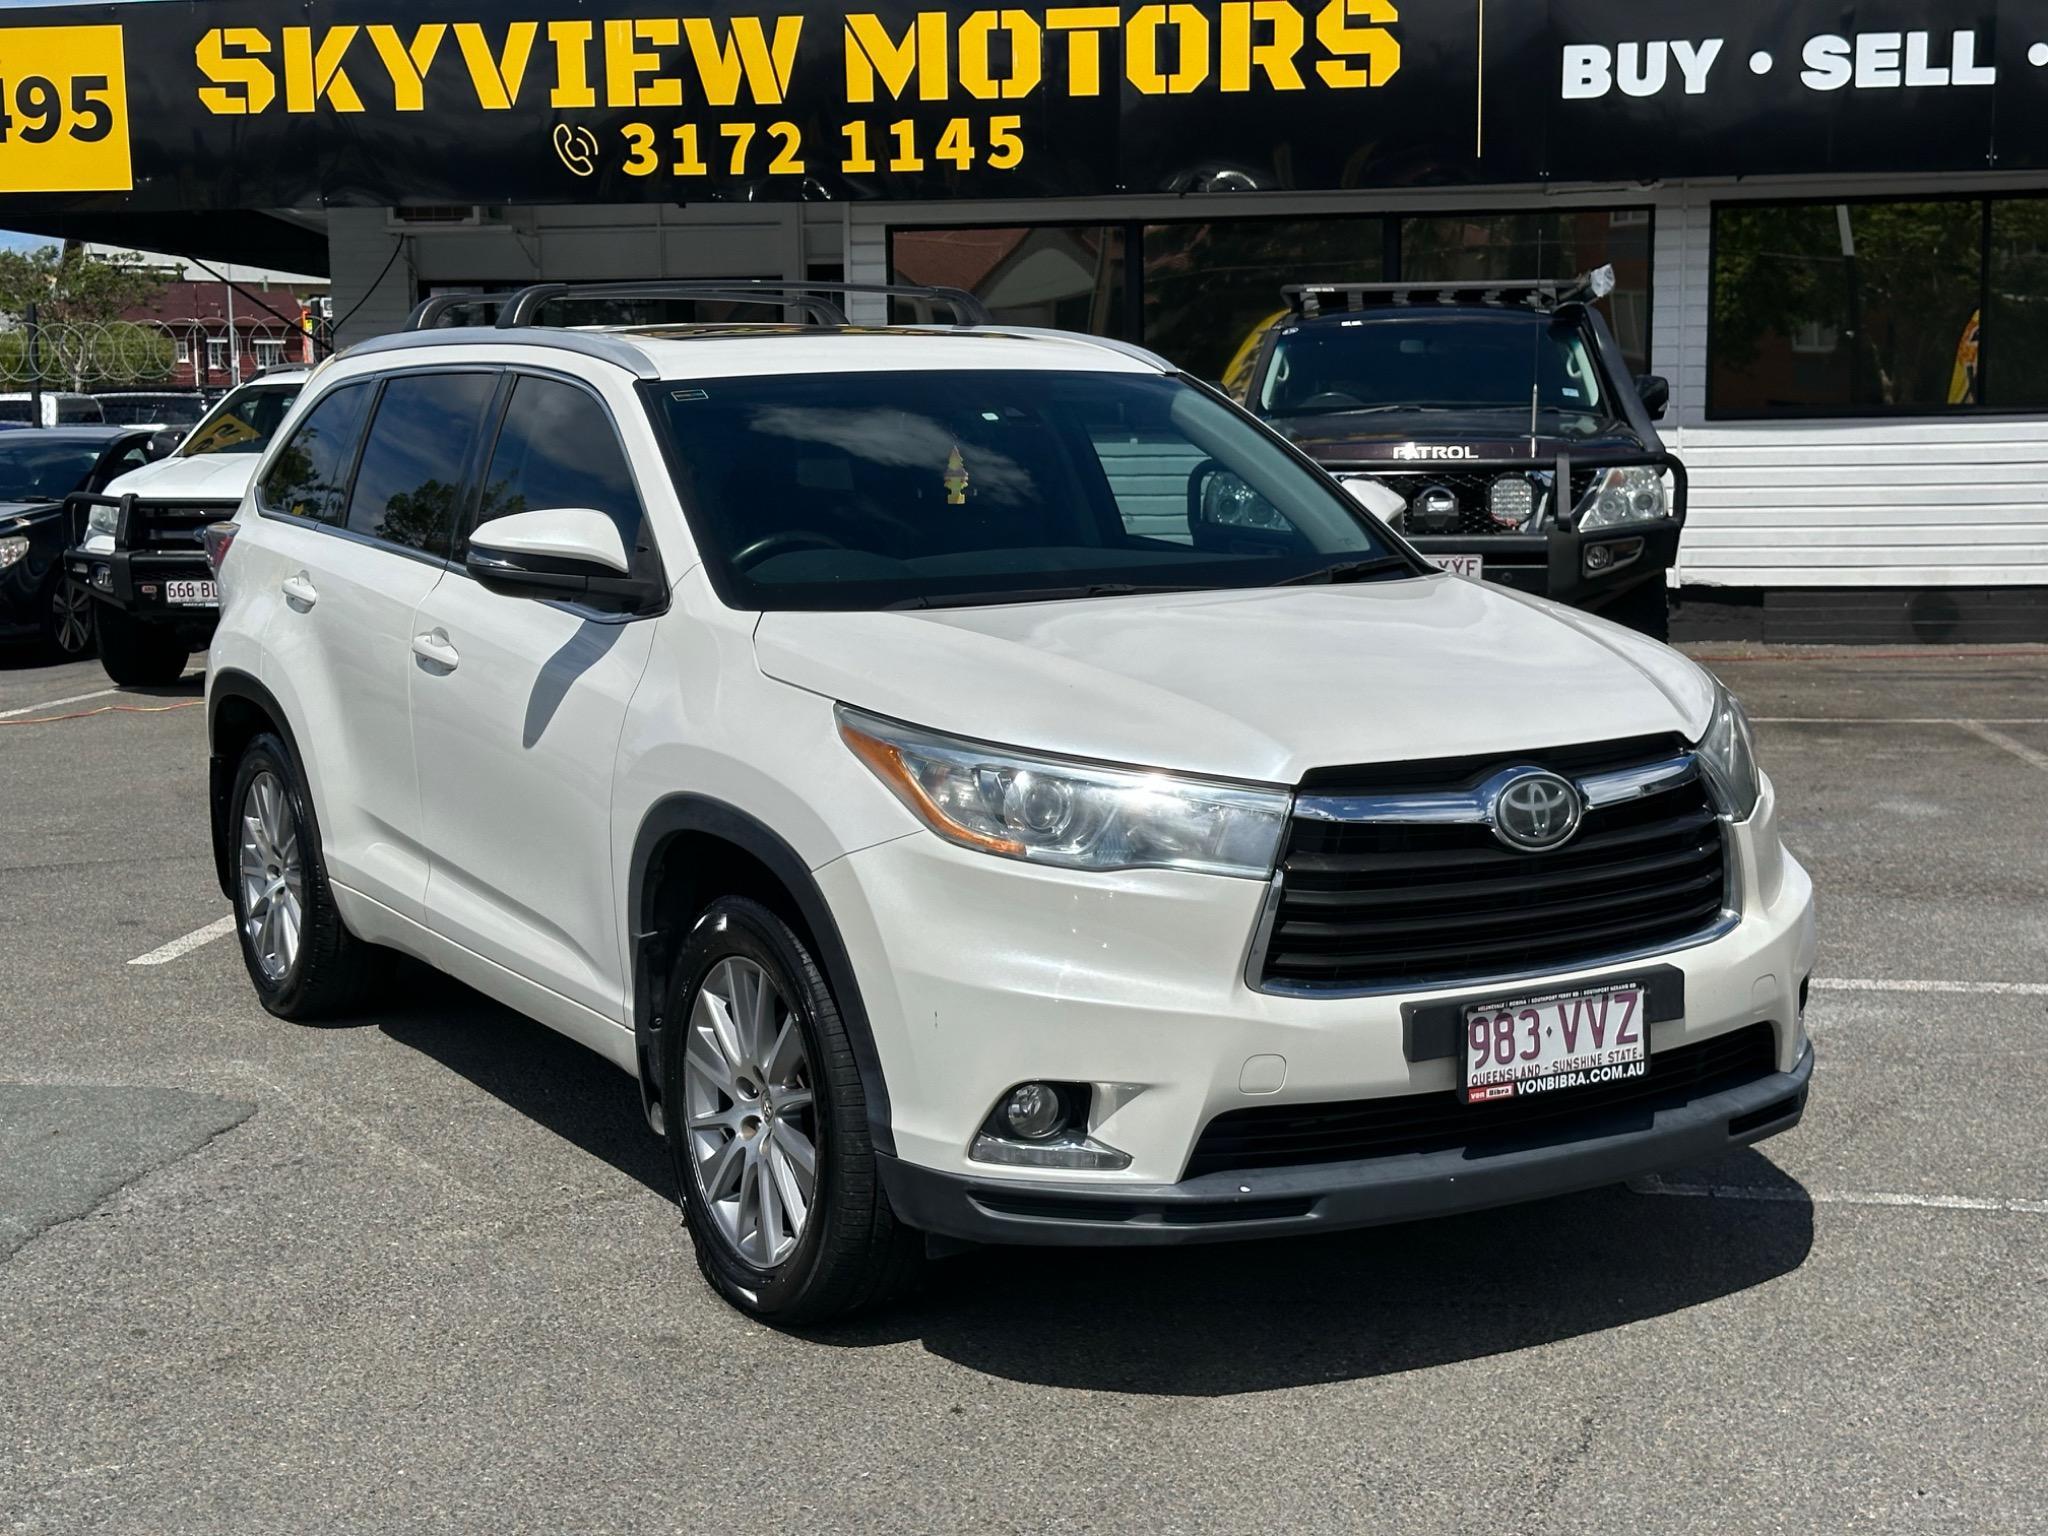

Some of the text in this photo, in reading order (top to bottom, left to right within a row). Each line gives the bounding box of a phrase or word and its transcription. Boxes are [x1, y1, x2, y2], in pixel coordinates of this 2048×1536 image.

[196, 0, 1401, 114] SKYVIEW MOTORS
[1562, 30, 1996, 99] BUY SELL
[621, 115, 1025, 176] 3172 1145
[1392, 441, 1479, 460] PATROL
[1471, 1063, 1541, 1086] QUEENSLAND
[1552, 1053, 1603, 1073] SUNSHINE
[1516, 1061, 1645, 1095] VONBIBRA.COM.AU
